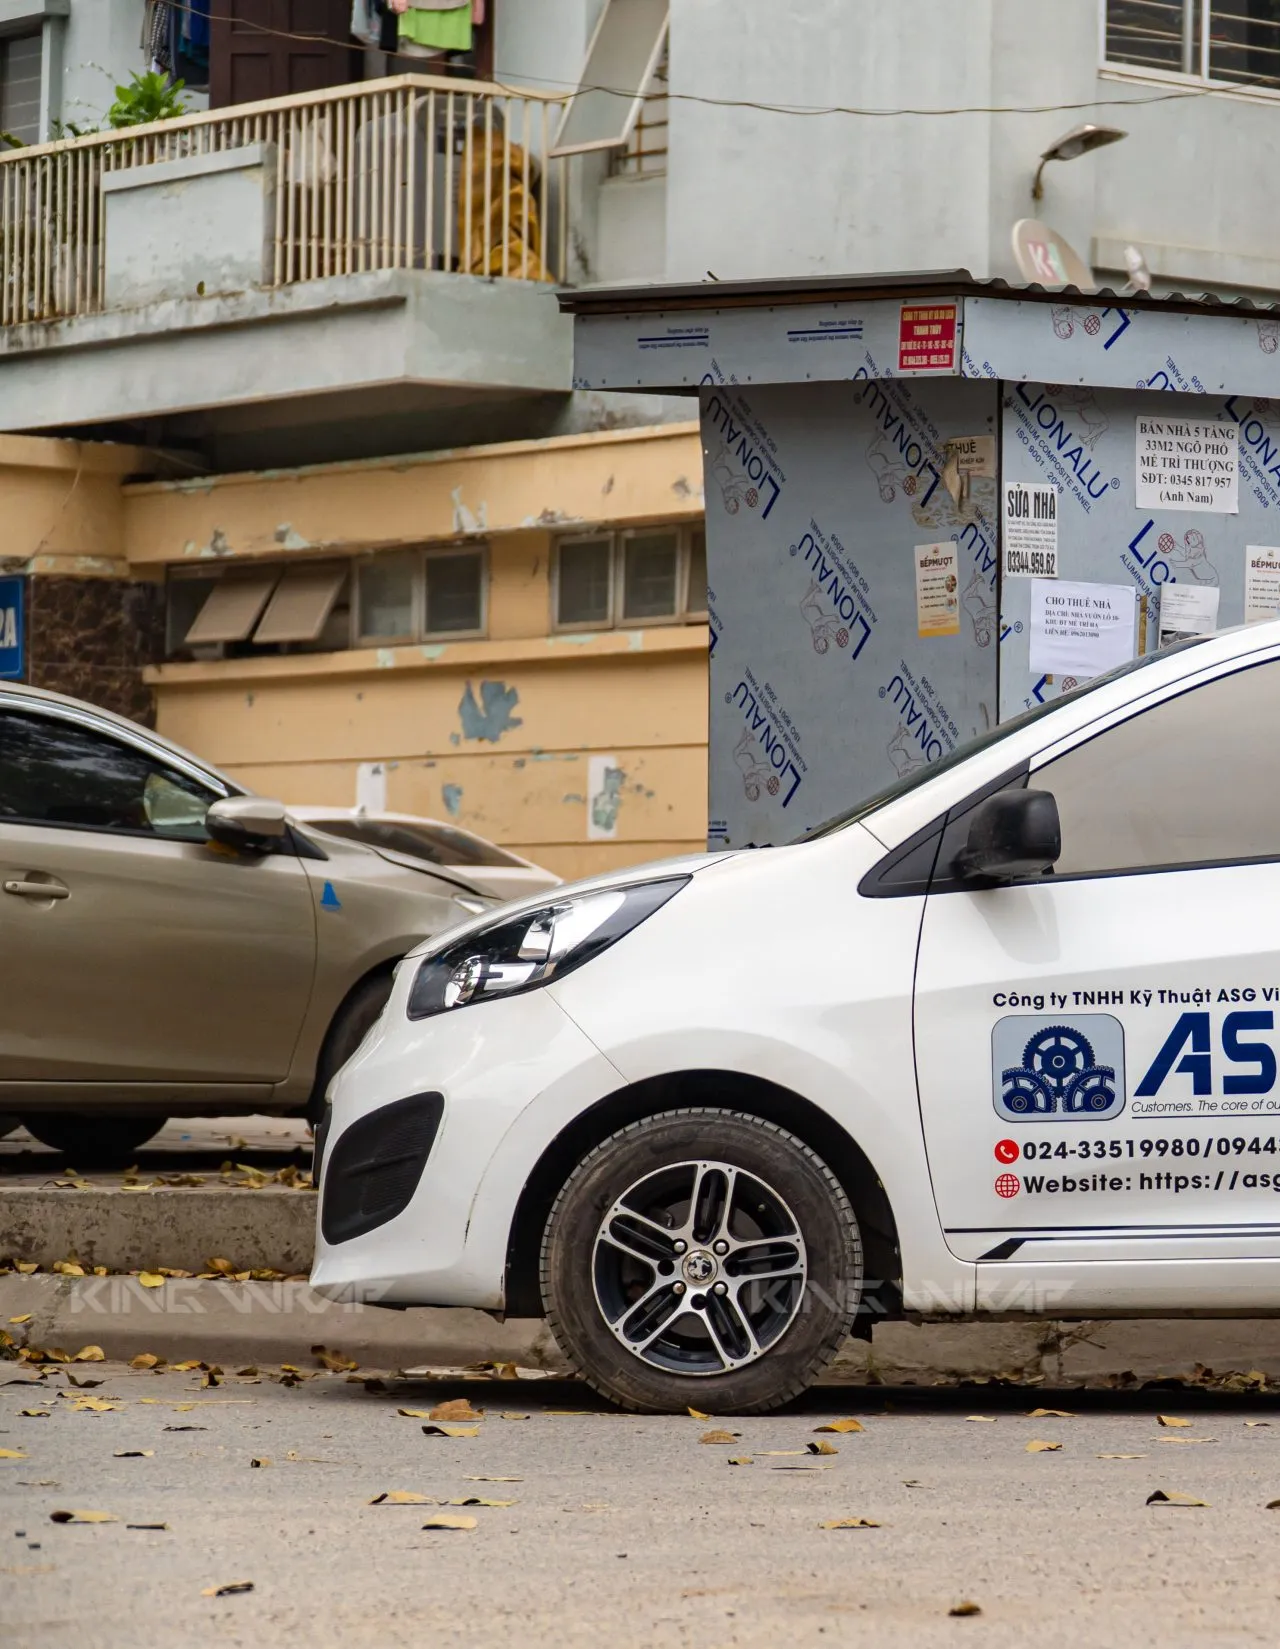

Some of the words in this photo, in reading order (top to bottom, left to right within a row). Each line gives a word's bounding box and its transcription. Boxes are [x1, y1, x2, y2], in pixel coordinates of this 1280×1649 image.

[1139, 421, 1164, 435] BÁN
[1166, 423, 1191, 437] NHÀ
[1194, 426, 1200, 438] 5
[1015, 427, 1030, 446] ISO
[1028, 444, 1045, 468] 9001
[1145, 440, 1173, 452] 33M2
[1176, 440, 1202, 454] NGÕ
[1160, 454, 1181, 469] TRÌ
[1183, 458, 1234, 474] THƯỢNG
[1038, 439, 1074, 488] COMPOSITE
[1071, 484, 1093, 515] PANEL
[1141, 472, 1167, 485] SĐT:
[1170, 474, 1193, 486] 0345
[1195, 476, 1212, 488] 817
[1214, 477, 1232, 489] 957
[1244, 455, 1279, 502] COMPOSITE
[1007, 483, 1029, 518] SỬA
[1033, 487, 1056, 520] NHÀ
[1159, 491, 1184, 503] (Anh
[1186, 492, 1214, 505] Nam)
[1252, 486, 1270, 509] 2008
[1119, 553, 1152, 597] ALUMINIUM
[1045, 596, 1065, 606] CHO
[1066, 597, 1091, 608] THUÊ
[1092, 598, 1112, 610] NHÀ
[992, 990, 1045, 1010] Công
[1049, 992, 1068, 1009] ty
[1072, 990, 1124, 1006] TNHH
[1129, 988, 1153, 1007] Kỹ
[1157, 988, 1212, 1008] Thuật
[1216, 988, 1257, 1004] ASG
[1131, 1100, 1194, 1113] Customers.
[1198, 1100, 1218, 1111] The
[1220, 1100, 1249, 1111] core
[1250, 1098, 1265, 1110] of
[1023, 1174, 1132, 1194] Website:
